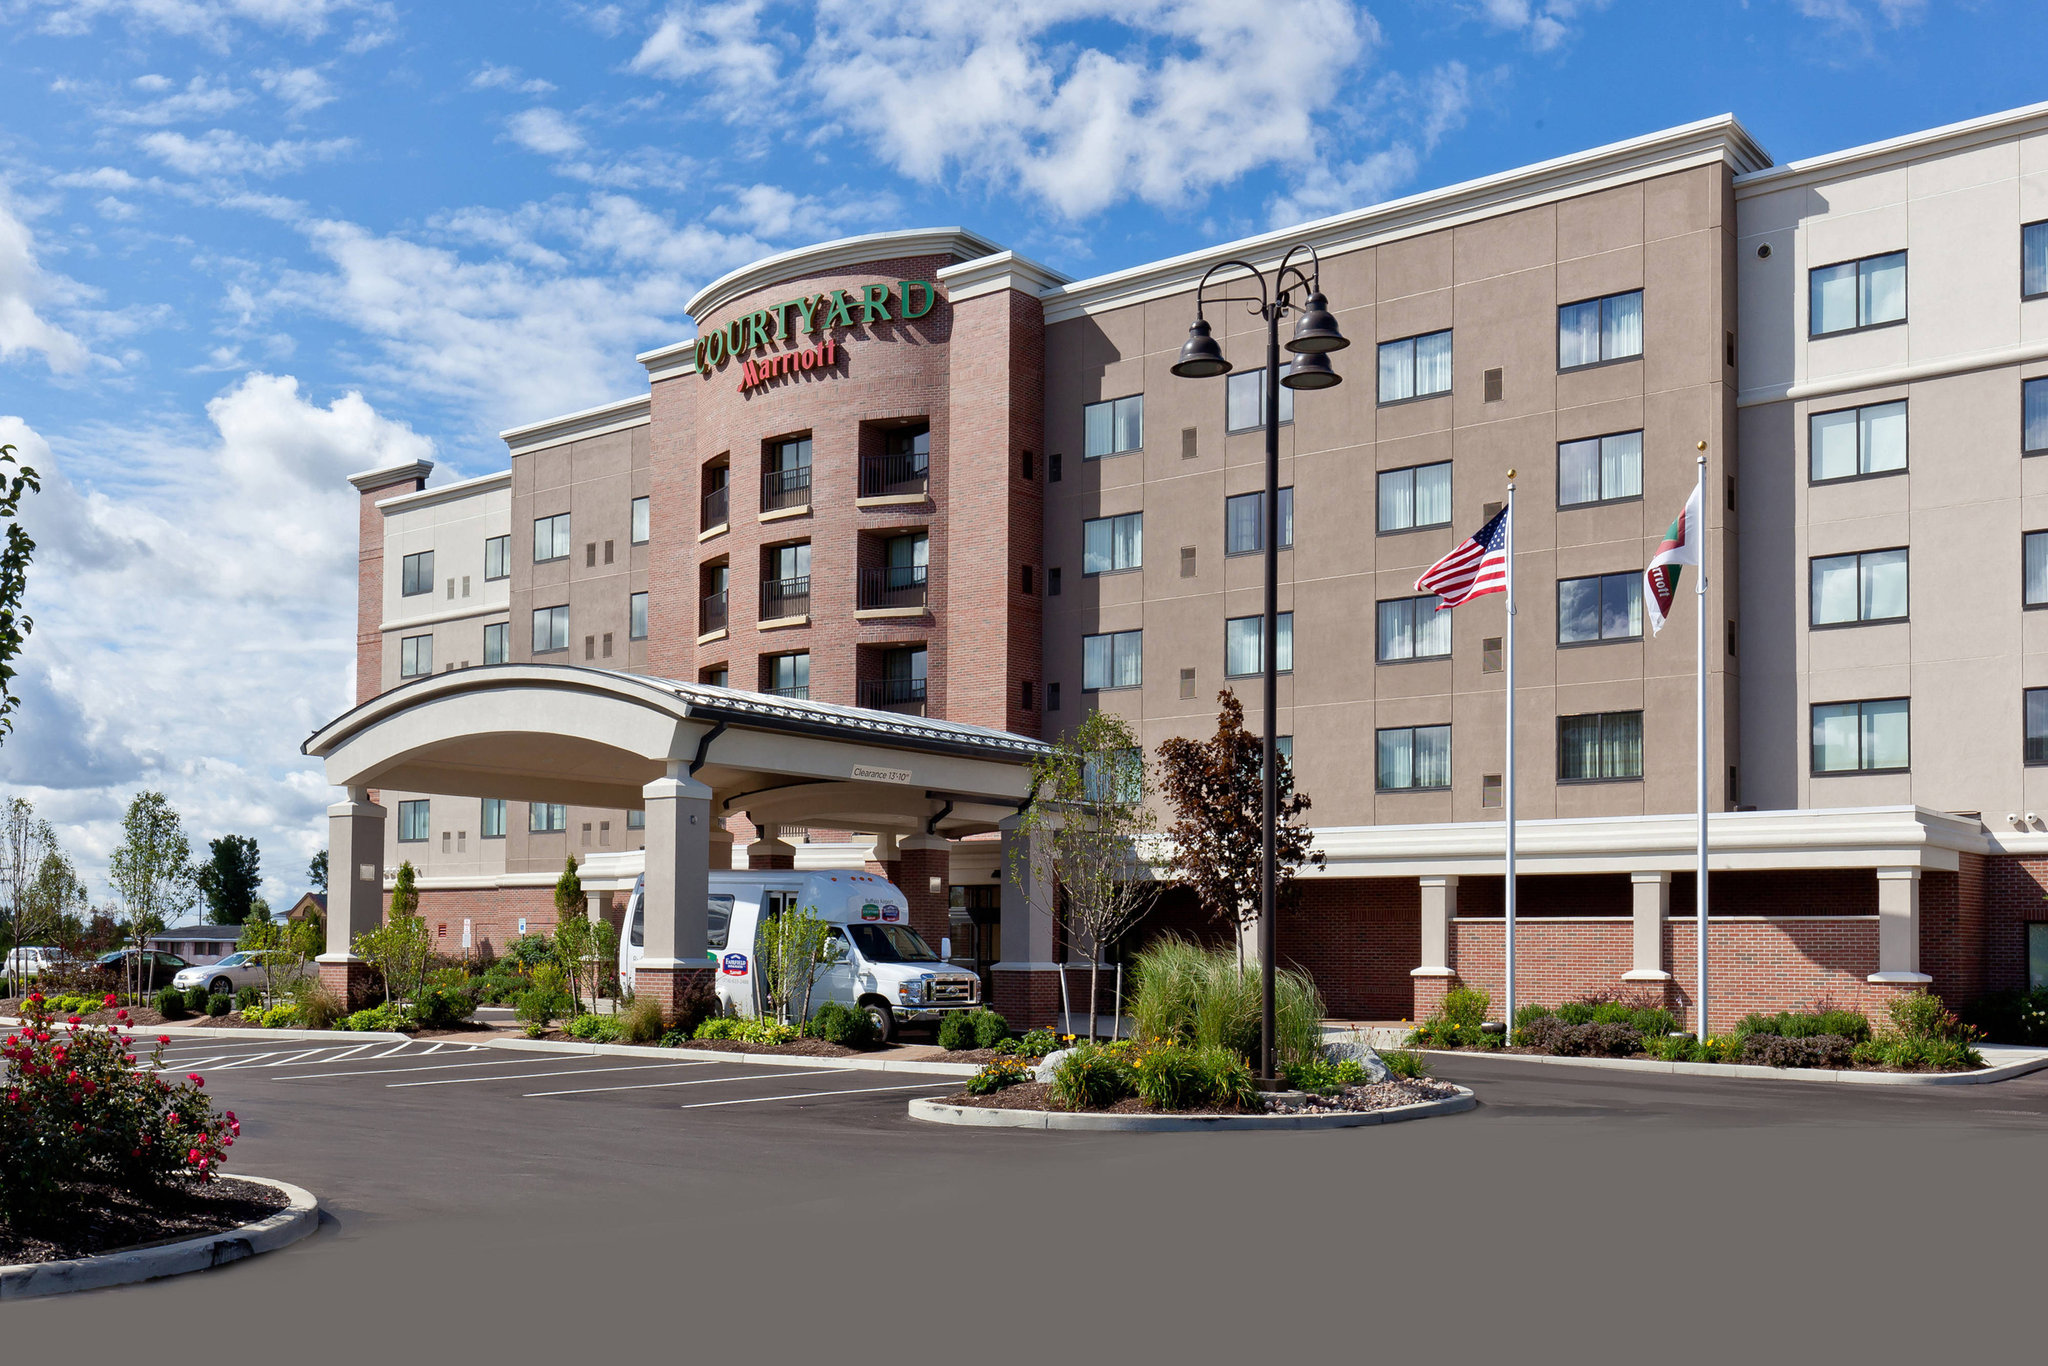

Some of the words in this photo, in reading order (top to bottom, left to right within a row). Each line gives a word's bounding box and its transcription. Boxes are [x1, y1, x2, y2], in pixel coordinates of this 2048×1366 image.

[694, 280, 935, 375] COURTYARD
[737, 338, 837, 393] Marriott
[1652, 567, 1670, 597] rriott
[854, 767, 887, 779] Clearance
